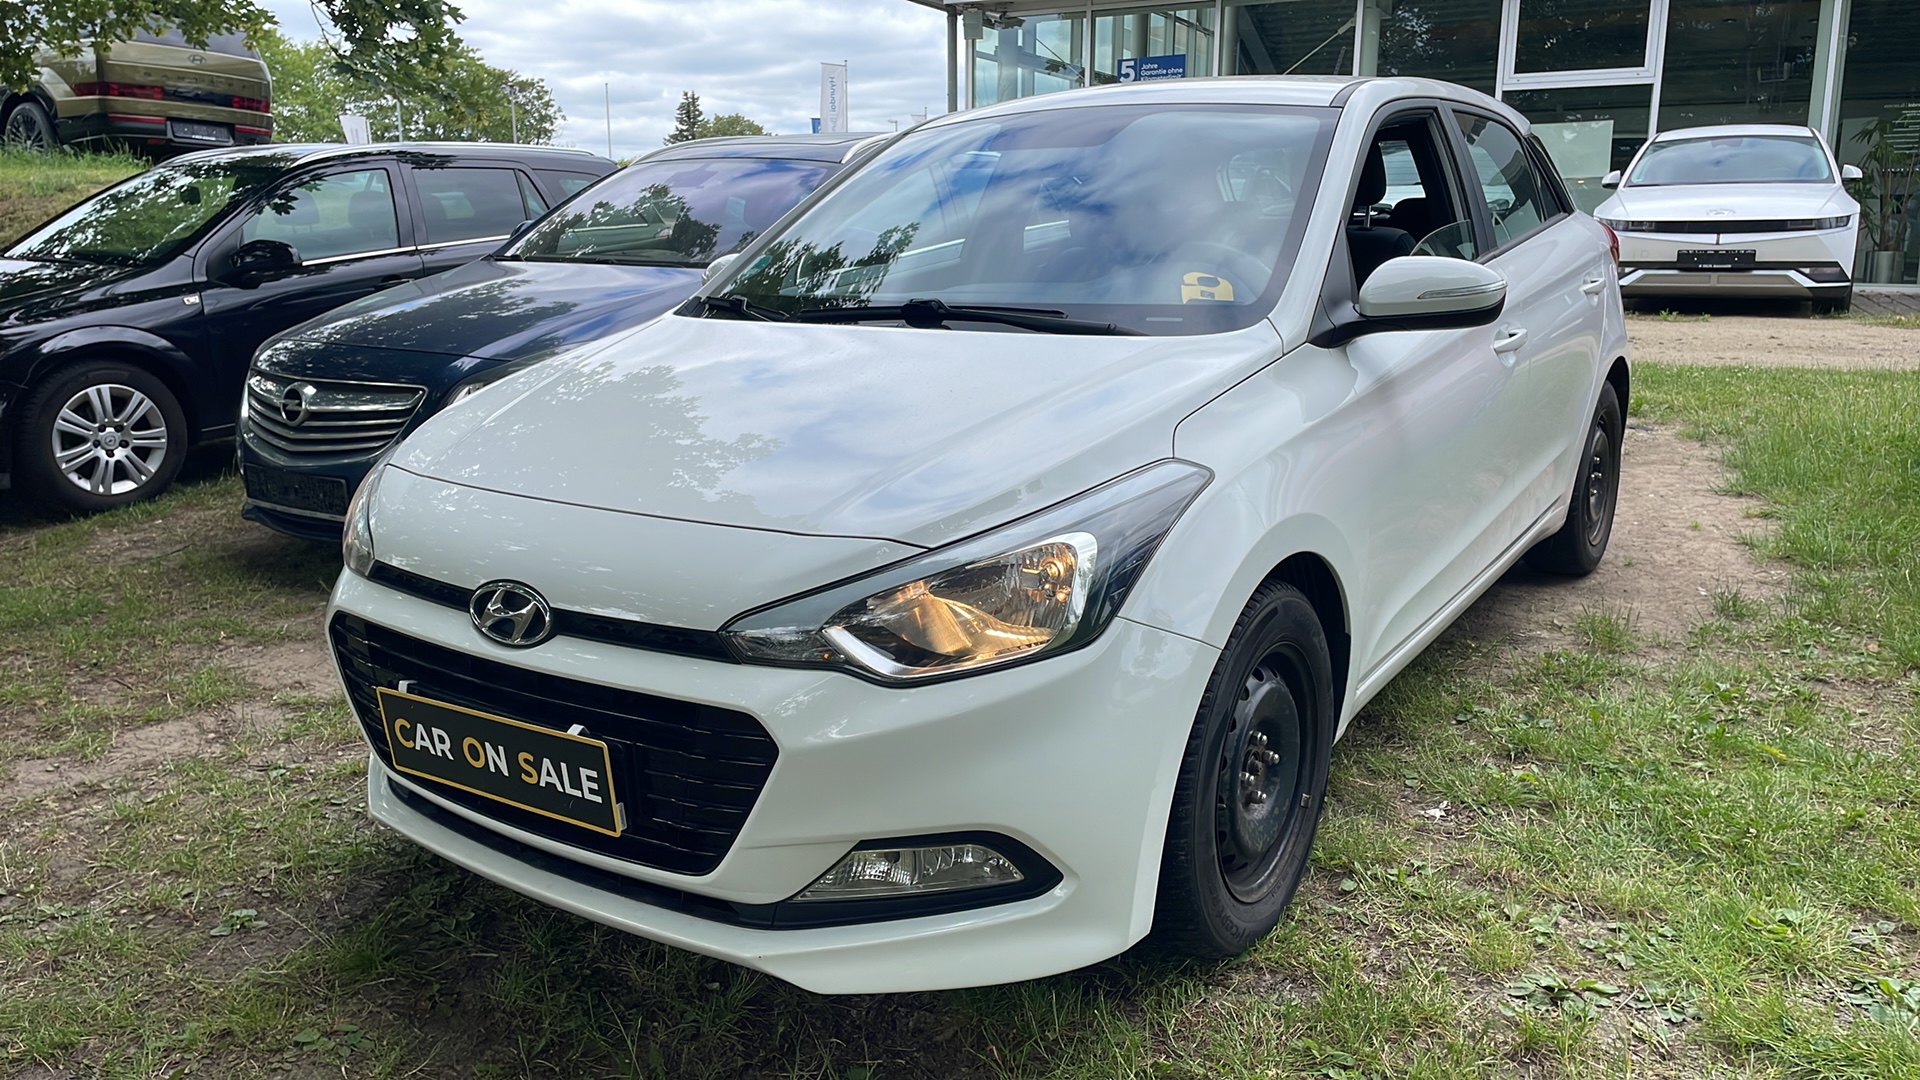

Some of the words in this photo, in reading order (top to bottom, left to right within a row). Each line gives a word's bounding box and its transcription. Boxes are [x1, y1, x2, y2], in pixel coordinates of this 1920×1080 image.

[1120, 60, 1136, 83] 5
[394, 718, 455, 761] CAR
[462, 736, 510, 777] ON
[517, 751, 603, 804] SALE
